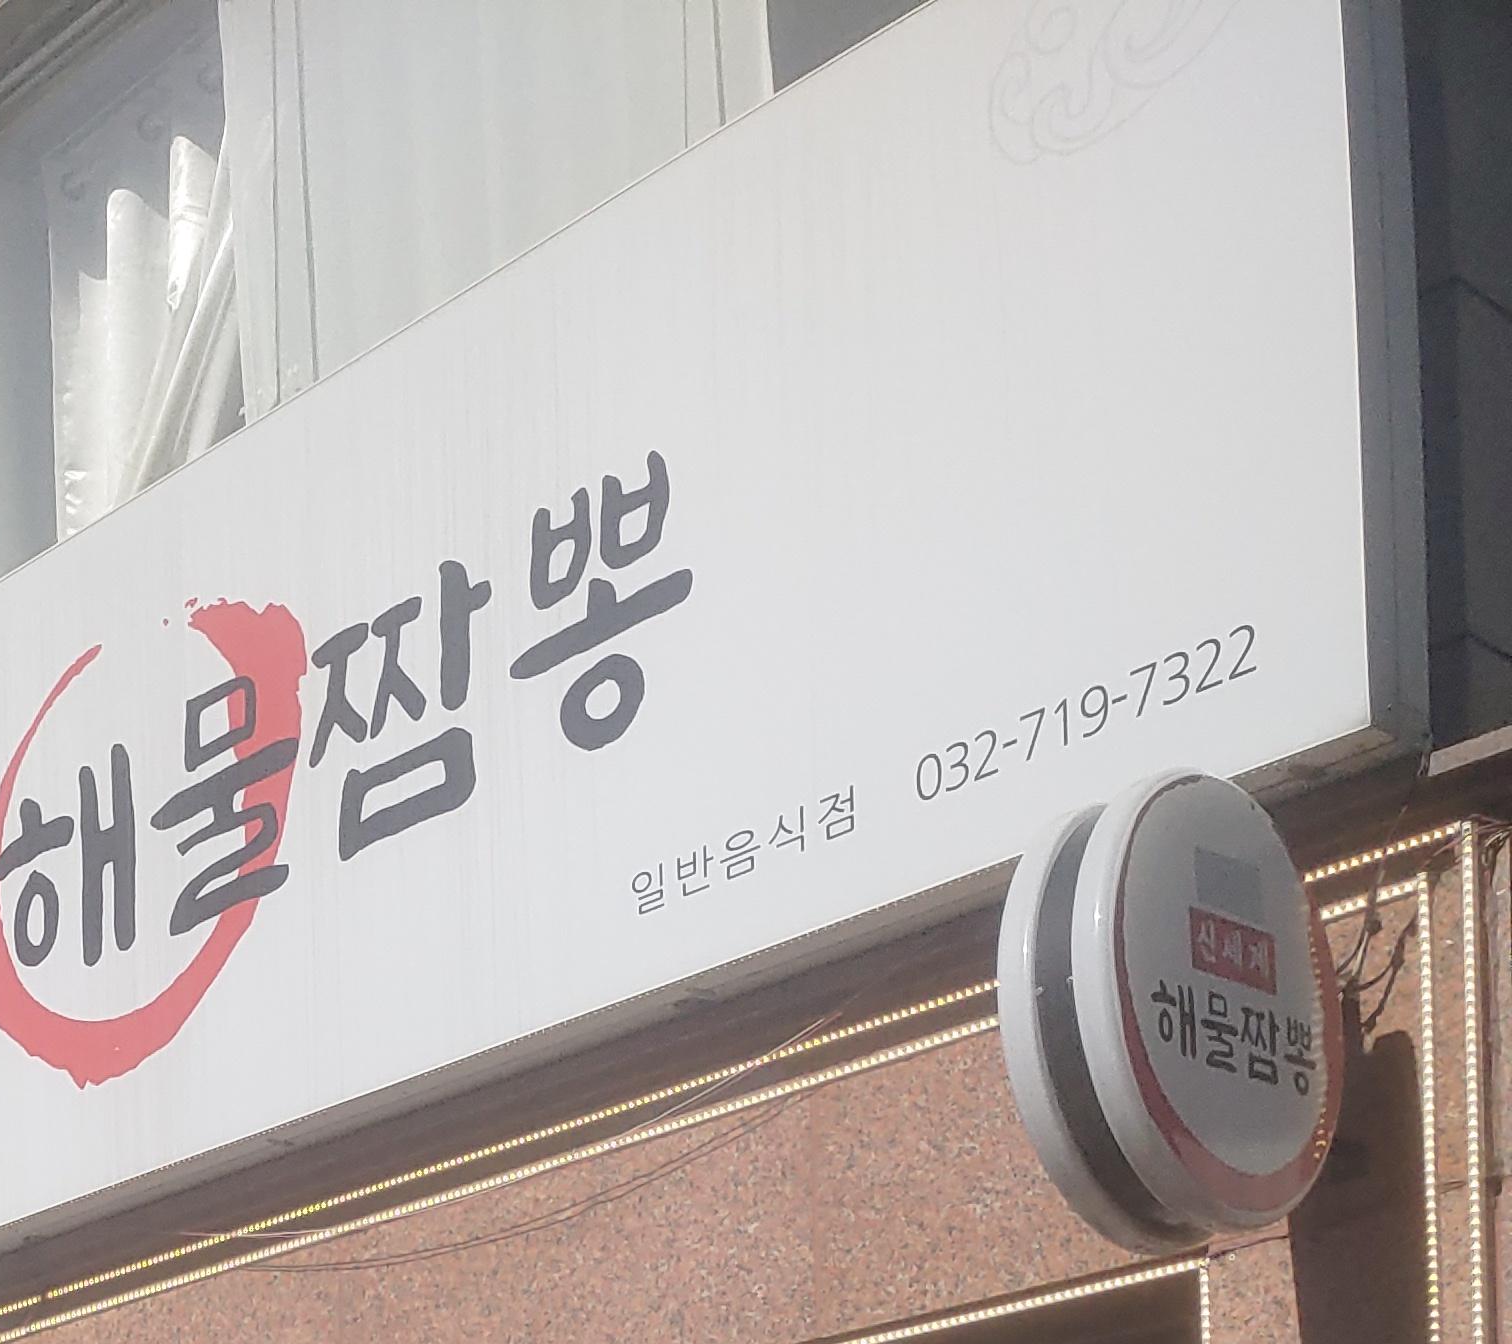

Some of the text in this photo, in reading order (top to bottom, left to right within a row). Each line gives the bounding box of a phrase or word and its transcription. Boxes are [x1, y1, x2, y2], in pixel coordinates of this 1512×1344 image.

[630, 623, 1257, 916] 일반음식점 032-719-7322
[1150, 979, 1317, 1097] 해물짬뽕
